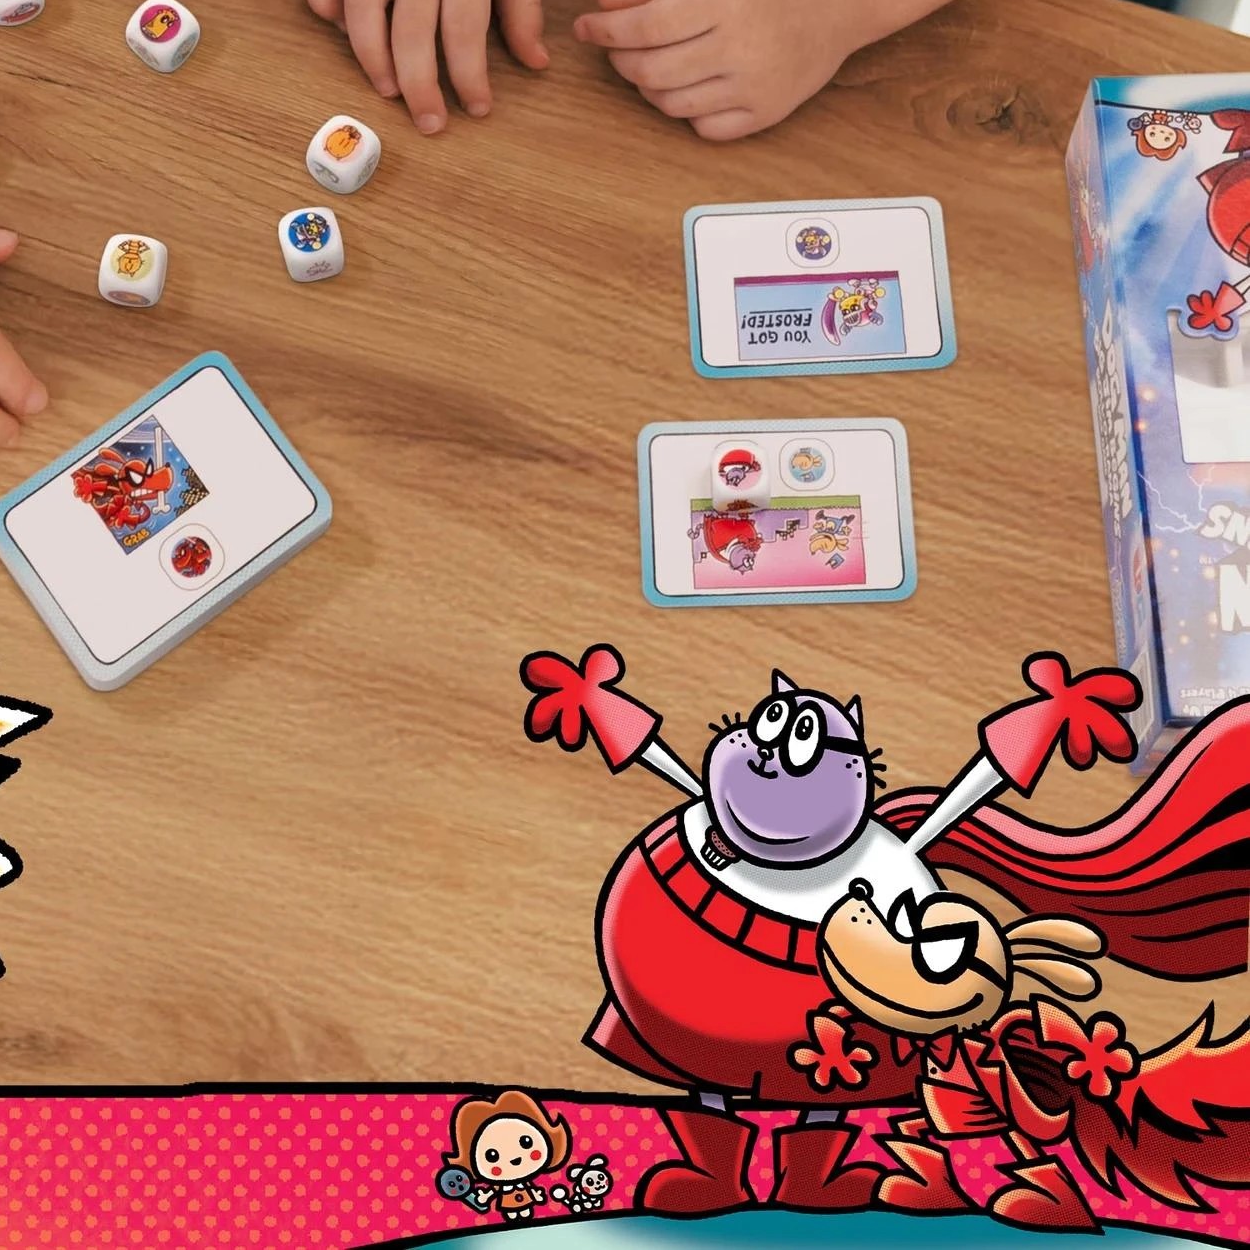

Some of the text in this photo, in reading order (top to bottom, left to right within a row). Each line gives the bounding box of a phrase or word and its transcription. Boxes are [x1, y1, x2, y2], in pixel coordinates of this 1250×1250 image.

[741, 313, 813, 329] FROSTED!
[747, 330, 812, 345] YOU GOT
[122, 527, 151, 547] GRAB
